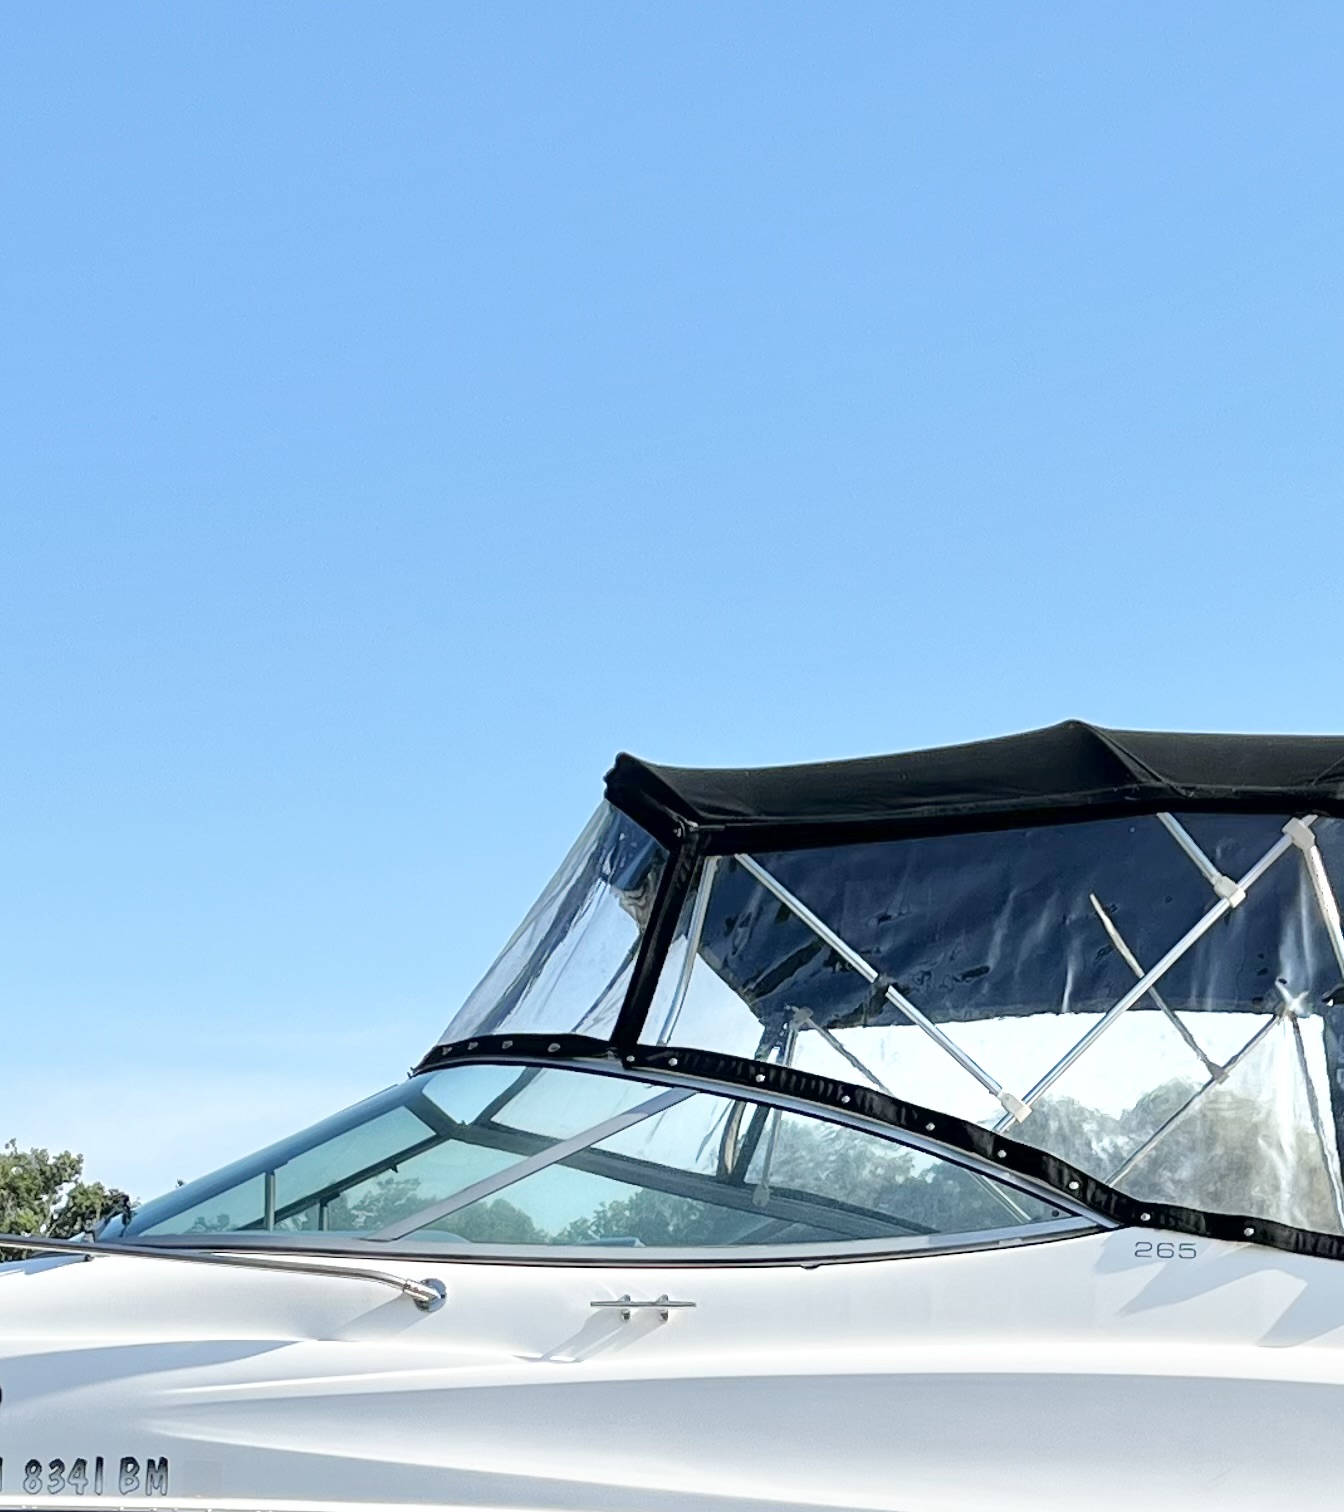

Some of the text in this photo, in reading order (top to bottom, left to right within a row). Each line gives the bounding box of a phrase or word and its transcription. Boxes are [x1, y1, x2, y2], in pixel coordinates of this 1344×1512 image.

[1134, 1241, 1197, 1259] 265
[22, 1456, 104, 1495] 8341
[119, 1456, 168, 1496] BM
